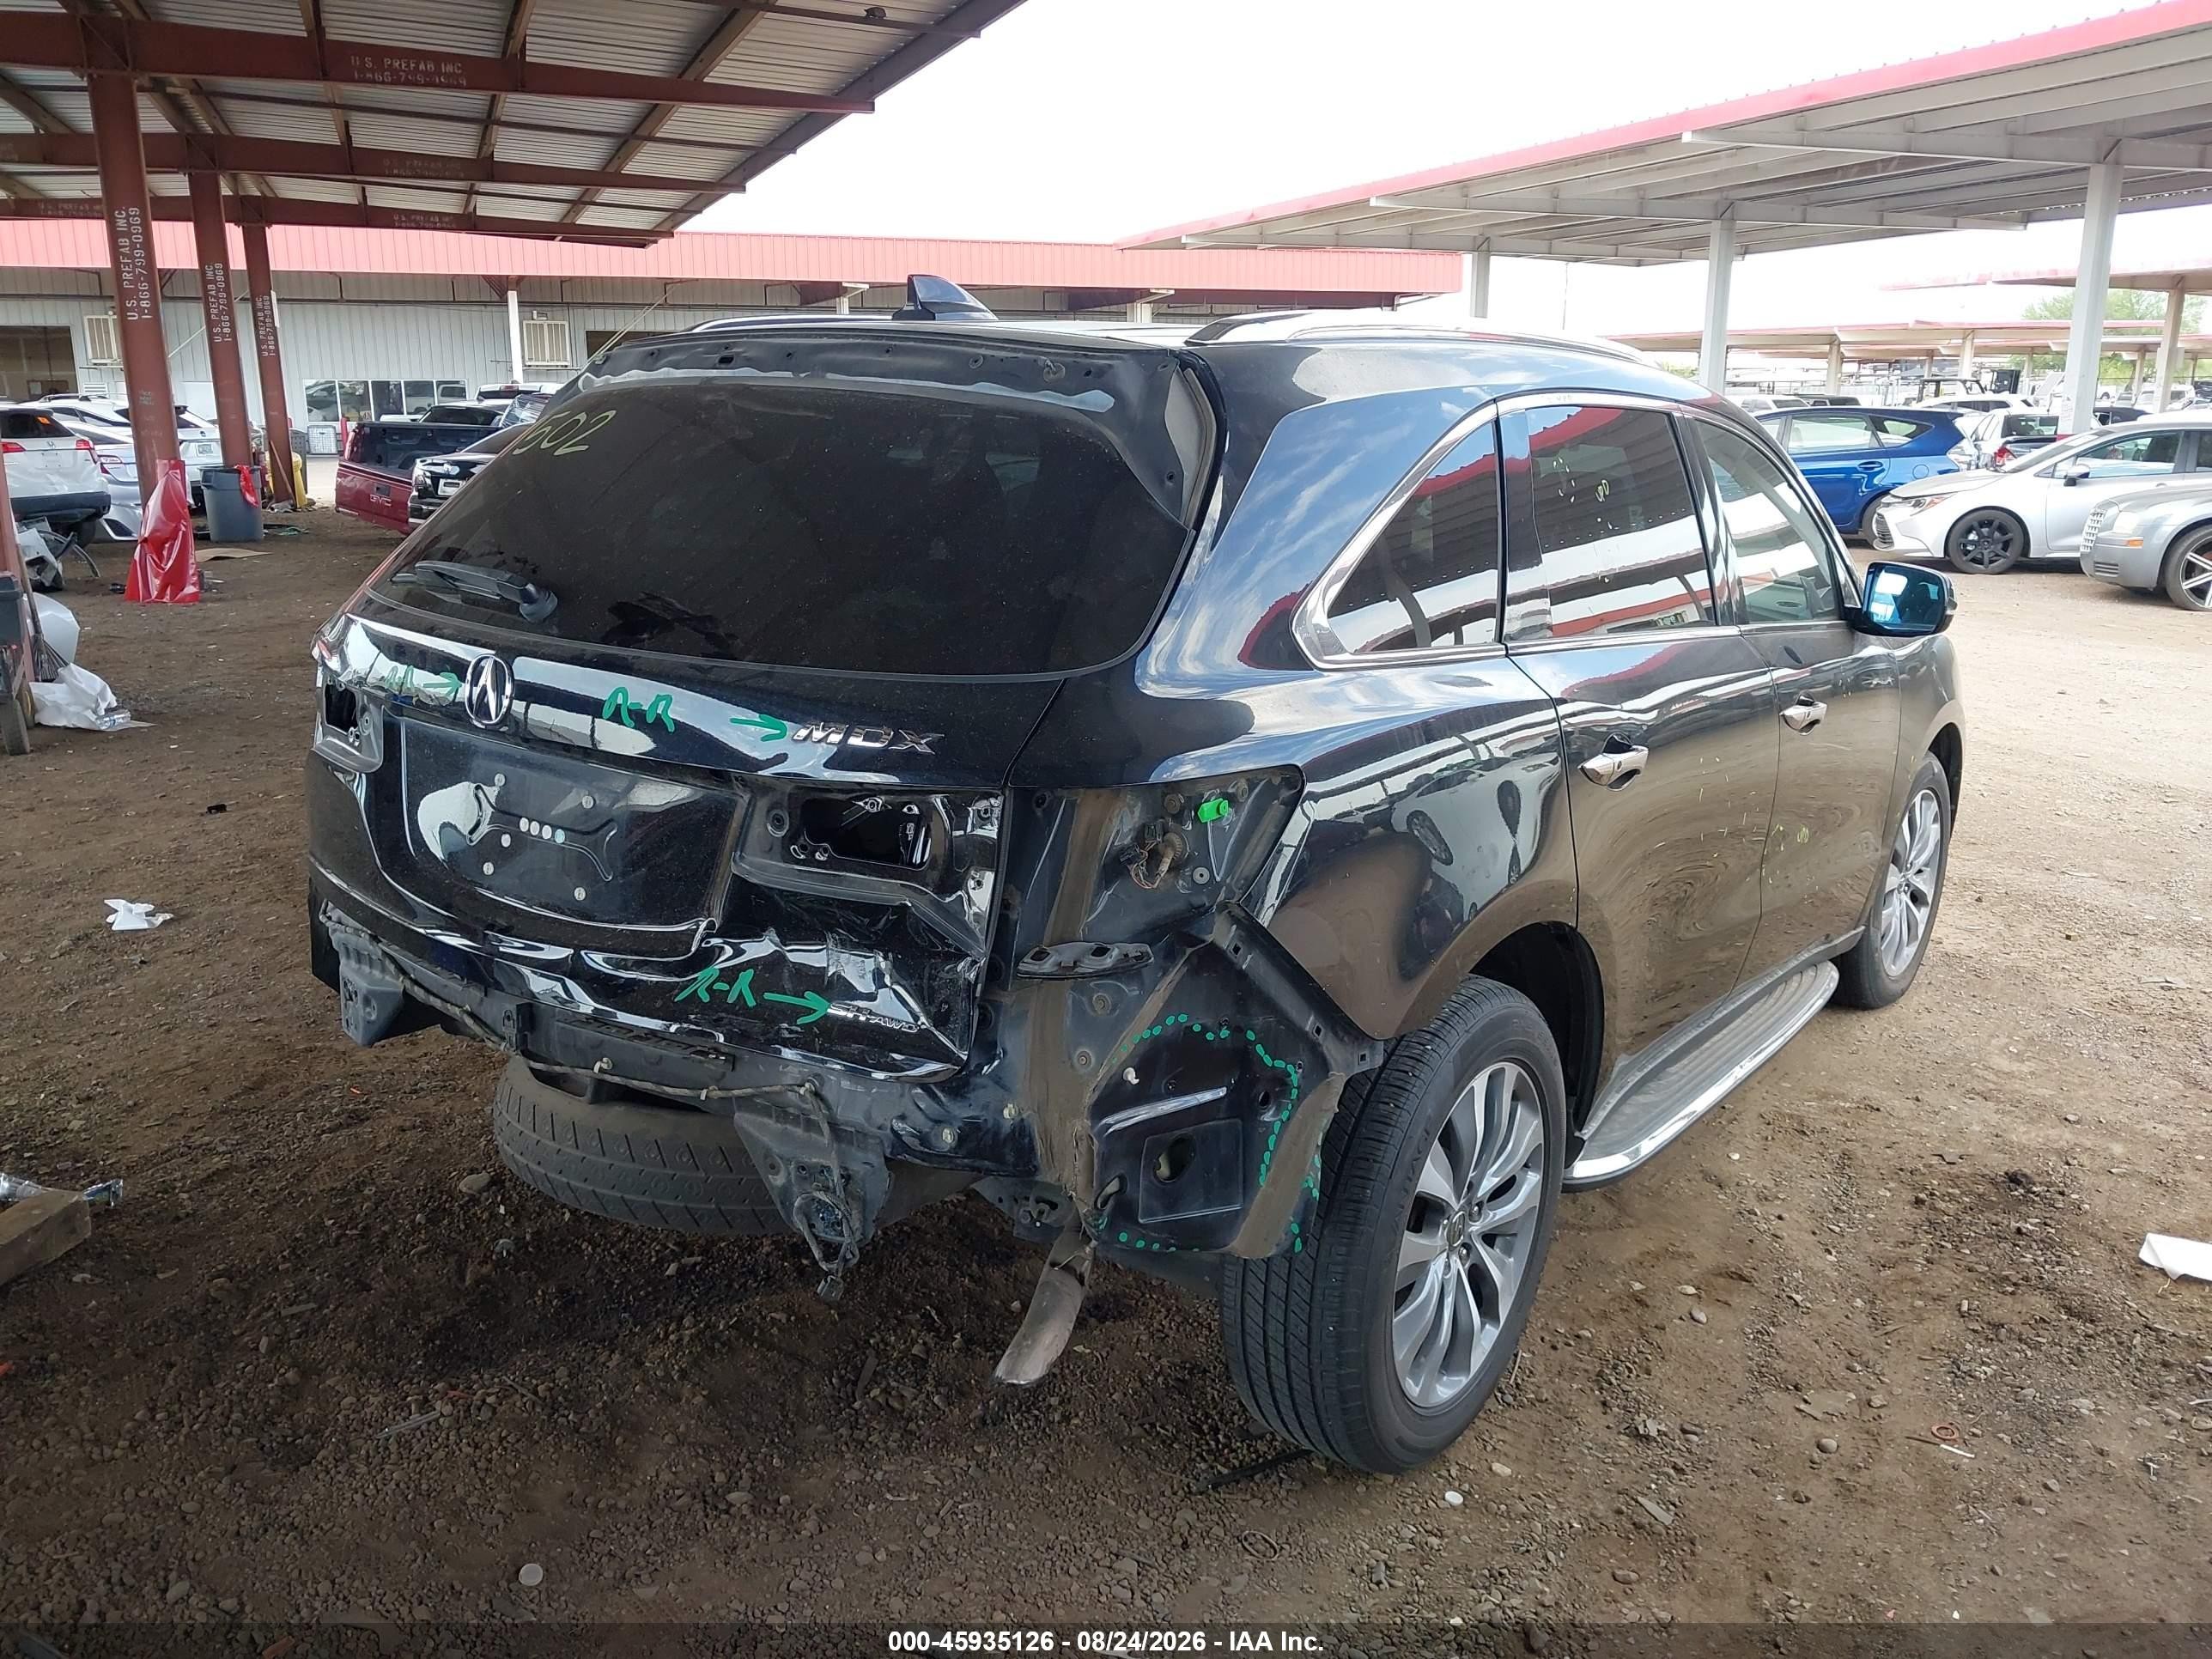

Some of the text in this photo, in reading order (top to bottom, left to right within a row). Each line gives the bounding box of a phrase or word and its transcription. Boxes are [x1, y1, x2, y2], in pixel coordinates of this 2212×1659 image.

[384, 58, 434, 72] PREFAB
[114, 206, 138, 320] U.S. PREFAB INC.
[128, 207, 153, 319] 1-866-799-0969
[207, 284, 220, 320] PREFAB
[214, 263, 233, 342] 1-866-799-0969
[257, 312, 267, 339] PREFAB
[792, 721, 945, 756] MDX
